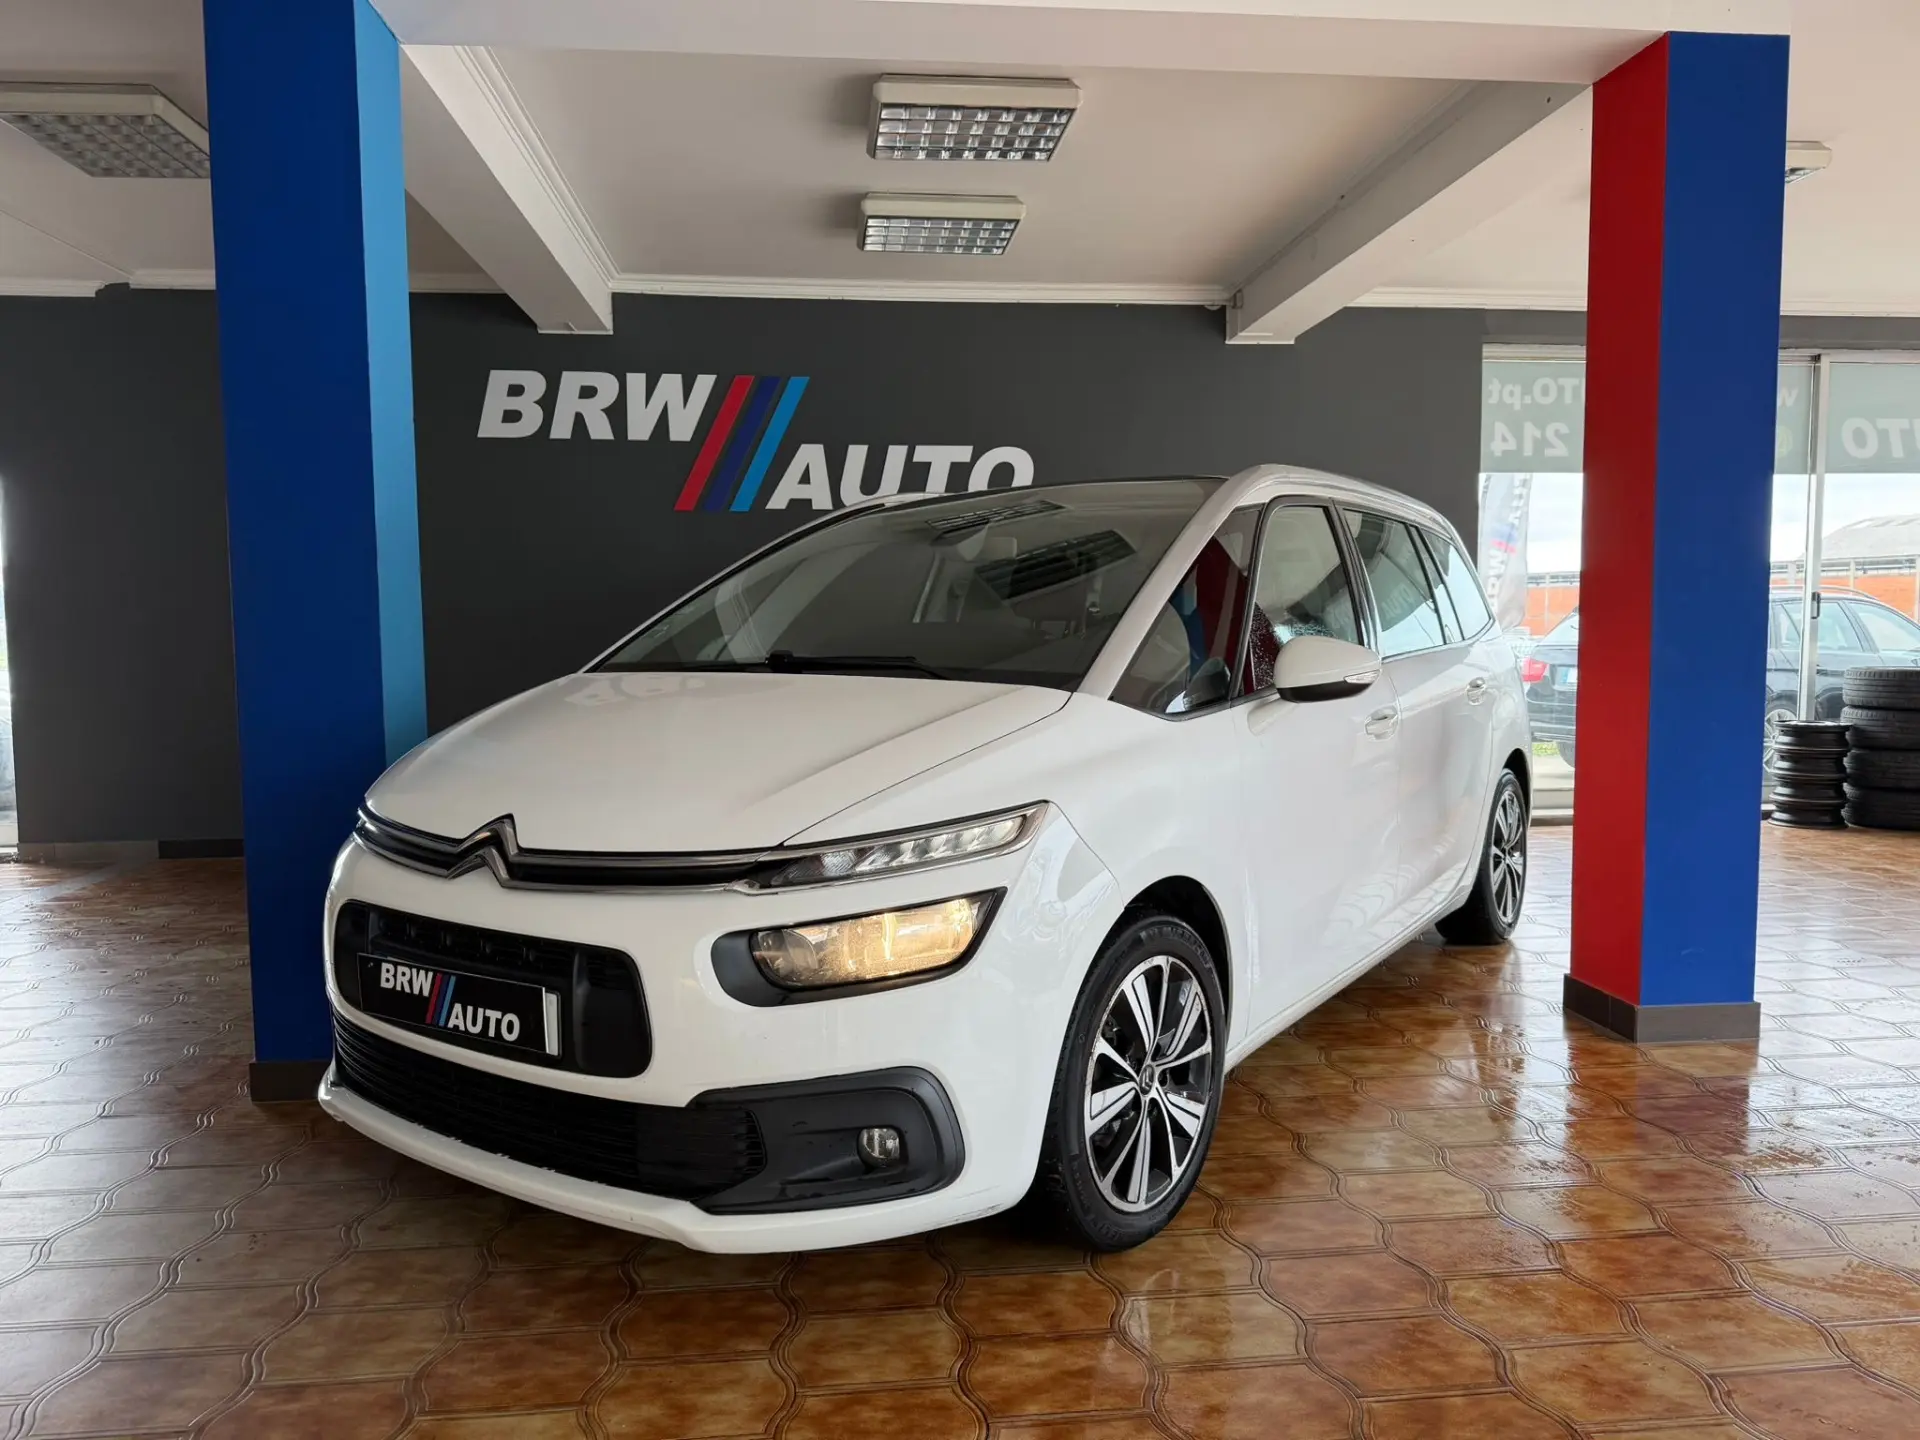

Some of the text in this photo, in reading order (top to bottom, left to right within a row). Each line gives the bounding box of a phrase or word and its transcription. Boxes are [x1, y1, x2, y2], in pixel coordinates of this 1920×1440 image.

[476, 369, 718, 442] BRW
[765, 443, 1036, 511] AUTO
[380, 961, 434, 998] BRW
[447, 1002, 520, 1042] AUTO
